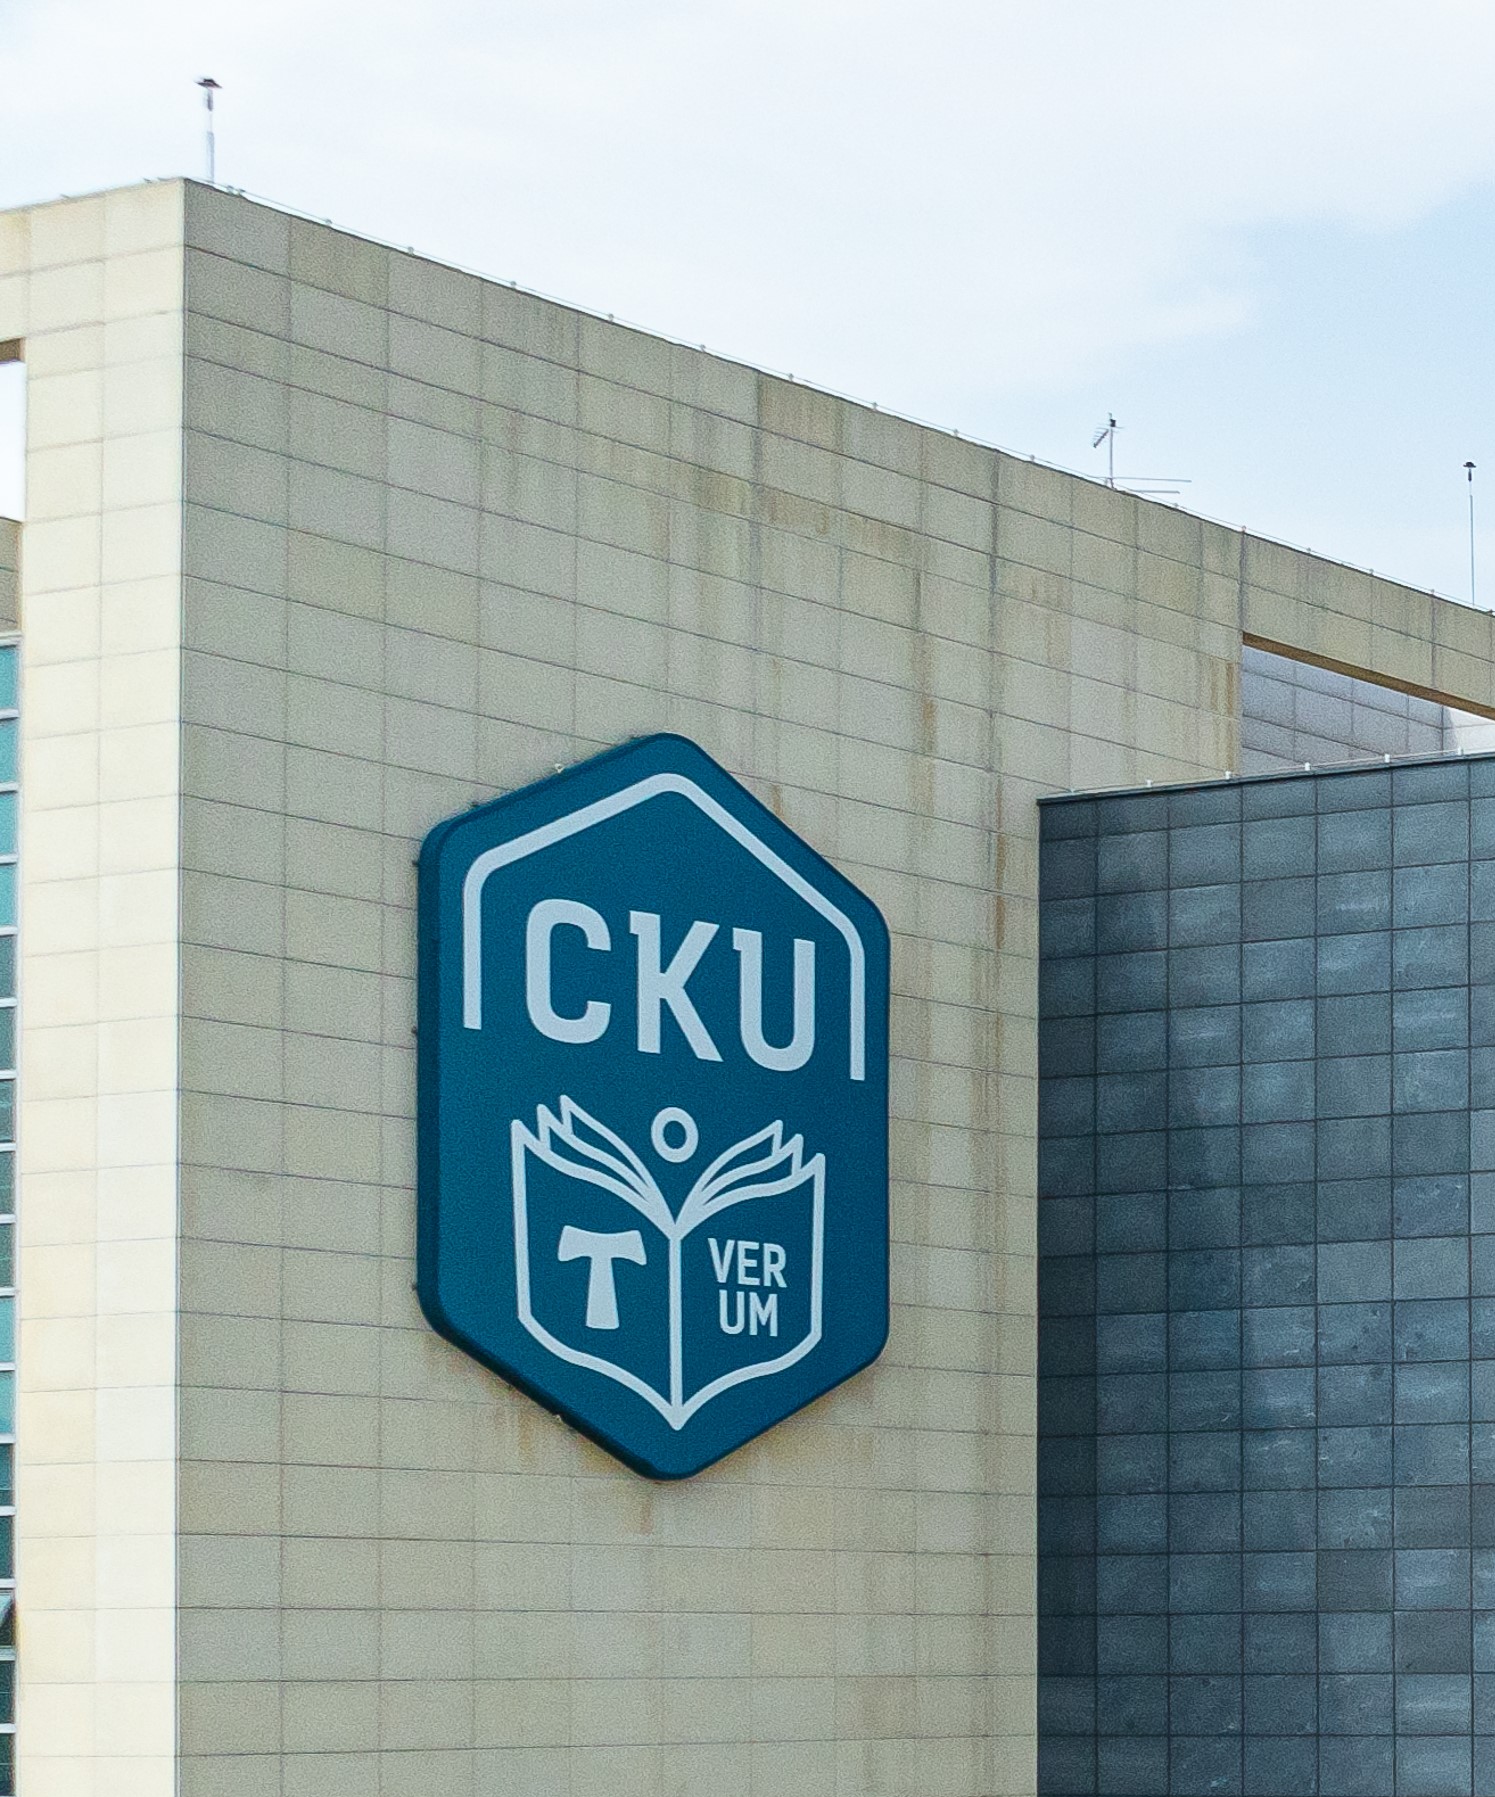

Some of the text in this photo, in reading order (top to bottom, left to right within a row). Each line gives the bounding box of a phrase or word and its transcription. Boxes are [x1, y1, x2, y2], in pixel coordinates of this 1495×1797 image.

[525, 898, 816, 1072] CKU
[708, 1236, 788, 1288] VER
[719, 1290, 779, 1337] UM
